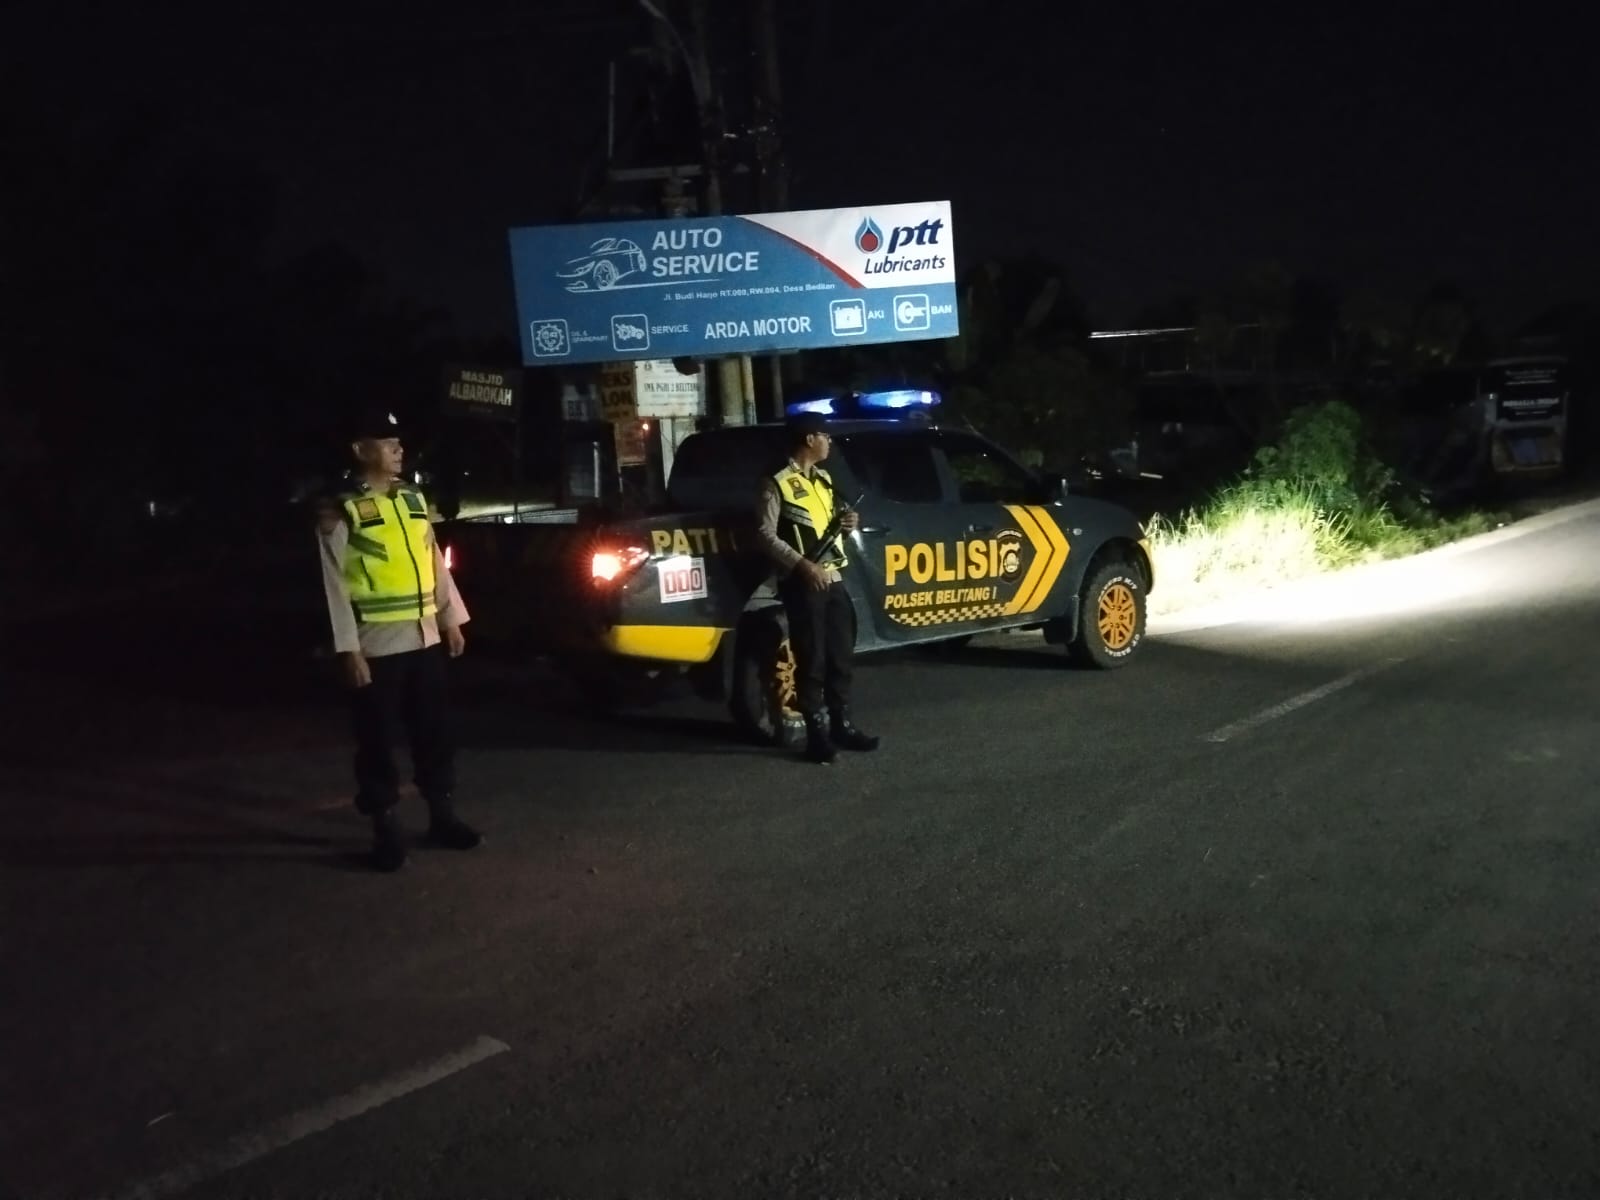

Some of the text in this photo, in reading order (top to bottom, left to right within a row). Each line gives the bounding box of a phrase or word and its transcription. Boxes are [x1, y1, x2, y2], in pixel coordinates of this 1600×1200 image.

[652, 228, 722, 250] AUTO
[887, 218, 943, 254] ptt
[652, 252, 760, 277] SERVICE
[864, 254, 946, 275] Lubricants
[784, 285, 804, 293] Desa
[867, 310, 885, 320] AKI
[931, 304, 952, 315] BAN
[651, 324, 689, 335] SERVICE
[704, 315, 812, 340] ARDA MOTOR
[461, 370, 504, 386] MASJID
[449, 382, 513, 407] ALBAROKAH
[884, 539, 998, 586] POLISI
[664, 568, 703, 594] 110
[884, 590, 933, 610] POLSEK
[935, 587, 991, 604] BELITANG
